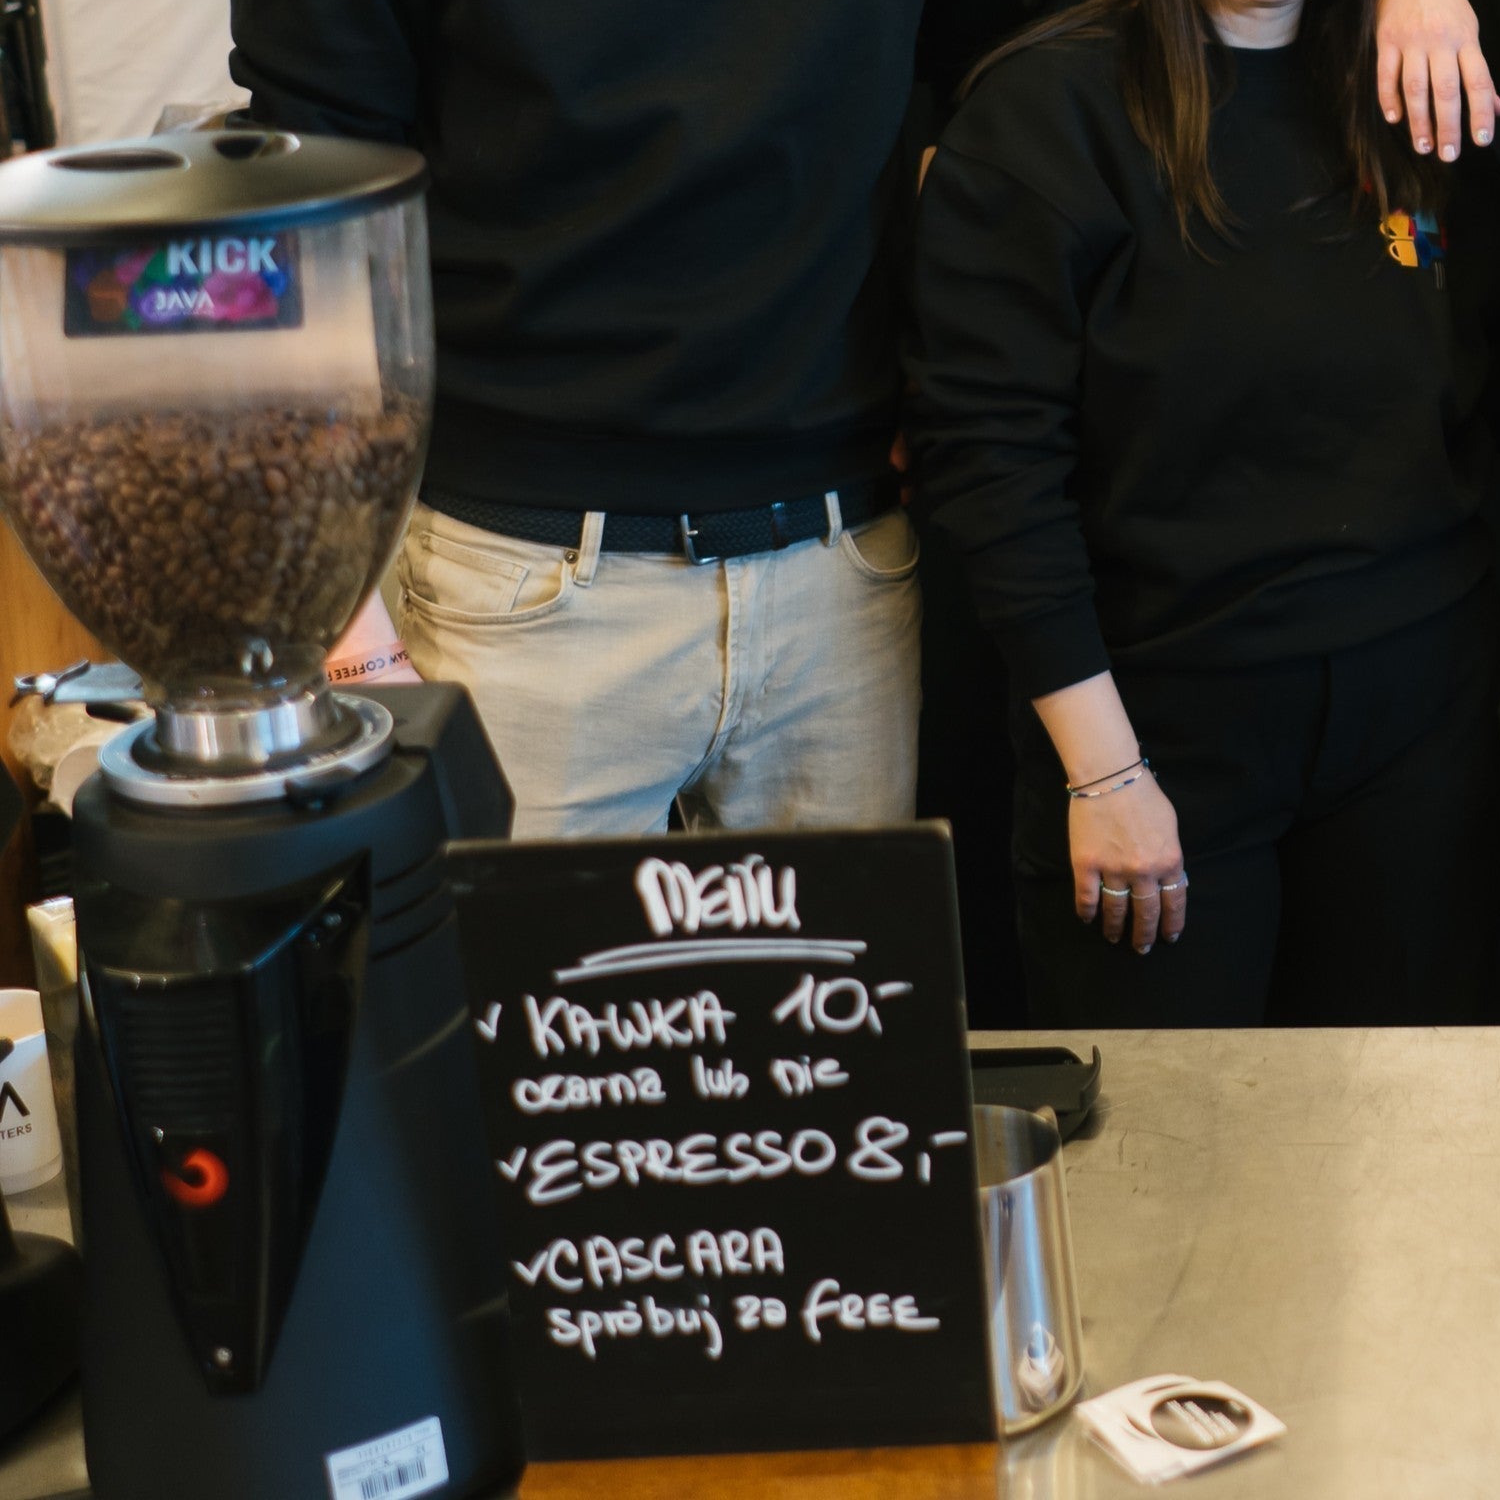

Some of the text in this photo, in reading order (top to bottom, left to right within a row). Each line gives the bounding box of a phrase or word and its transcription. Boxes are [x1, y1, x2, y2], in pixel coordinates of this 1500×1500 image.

[167, 237, 280, 276] KICK
[155, 288, 216, 311] JAVA
[334, 657, 386, 681] COFFEE
[521, 989, 737, 1060] KAWKA
[690, 1053, 751, 1100] lub
[525, 1127, 837, 1206] ESPRESSO
[543, 1226, 785, 1293] CASCARA
[732, 1294, 788, 1331] za
